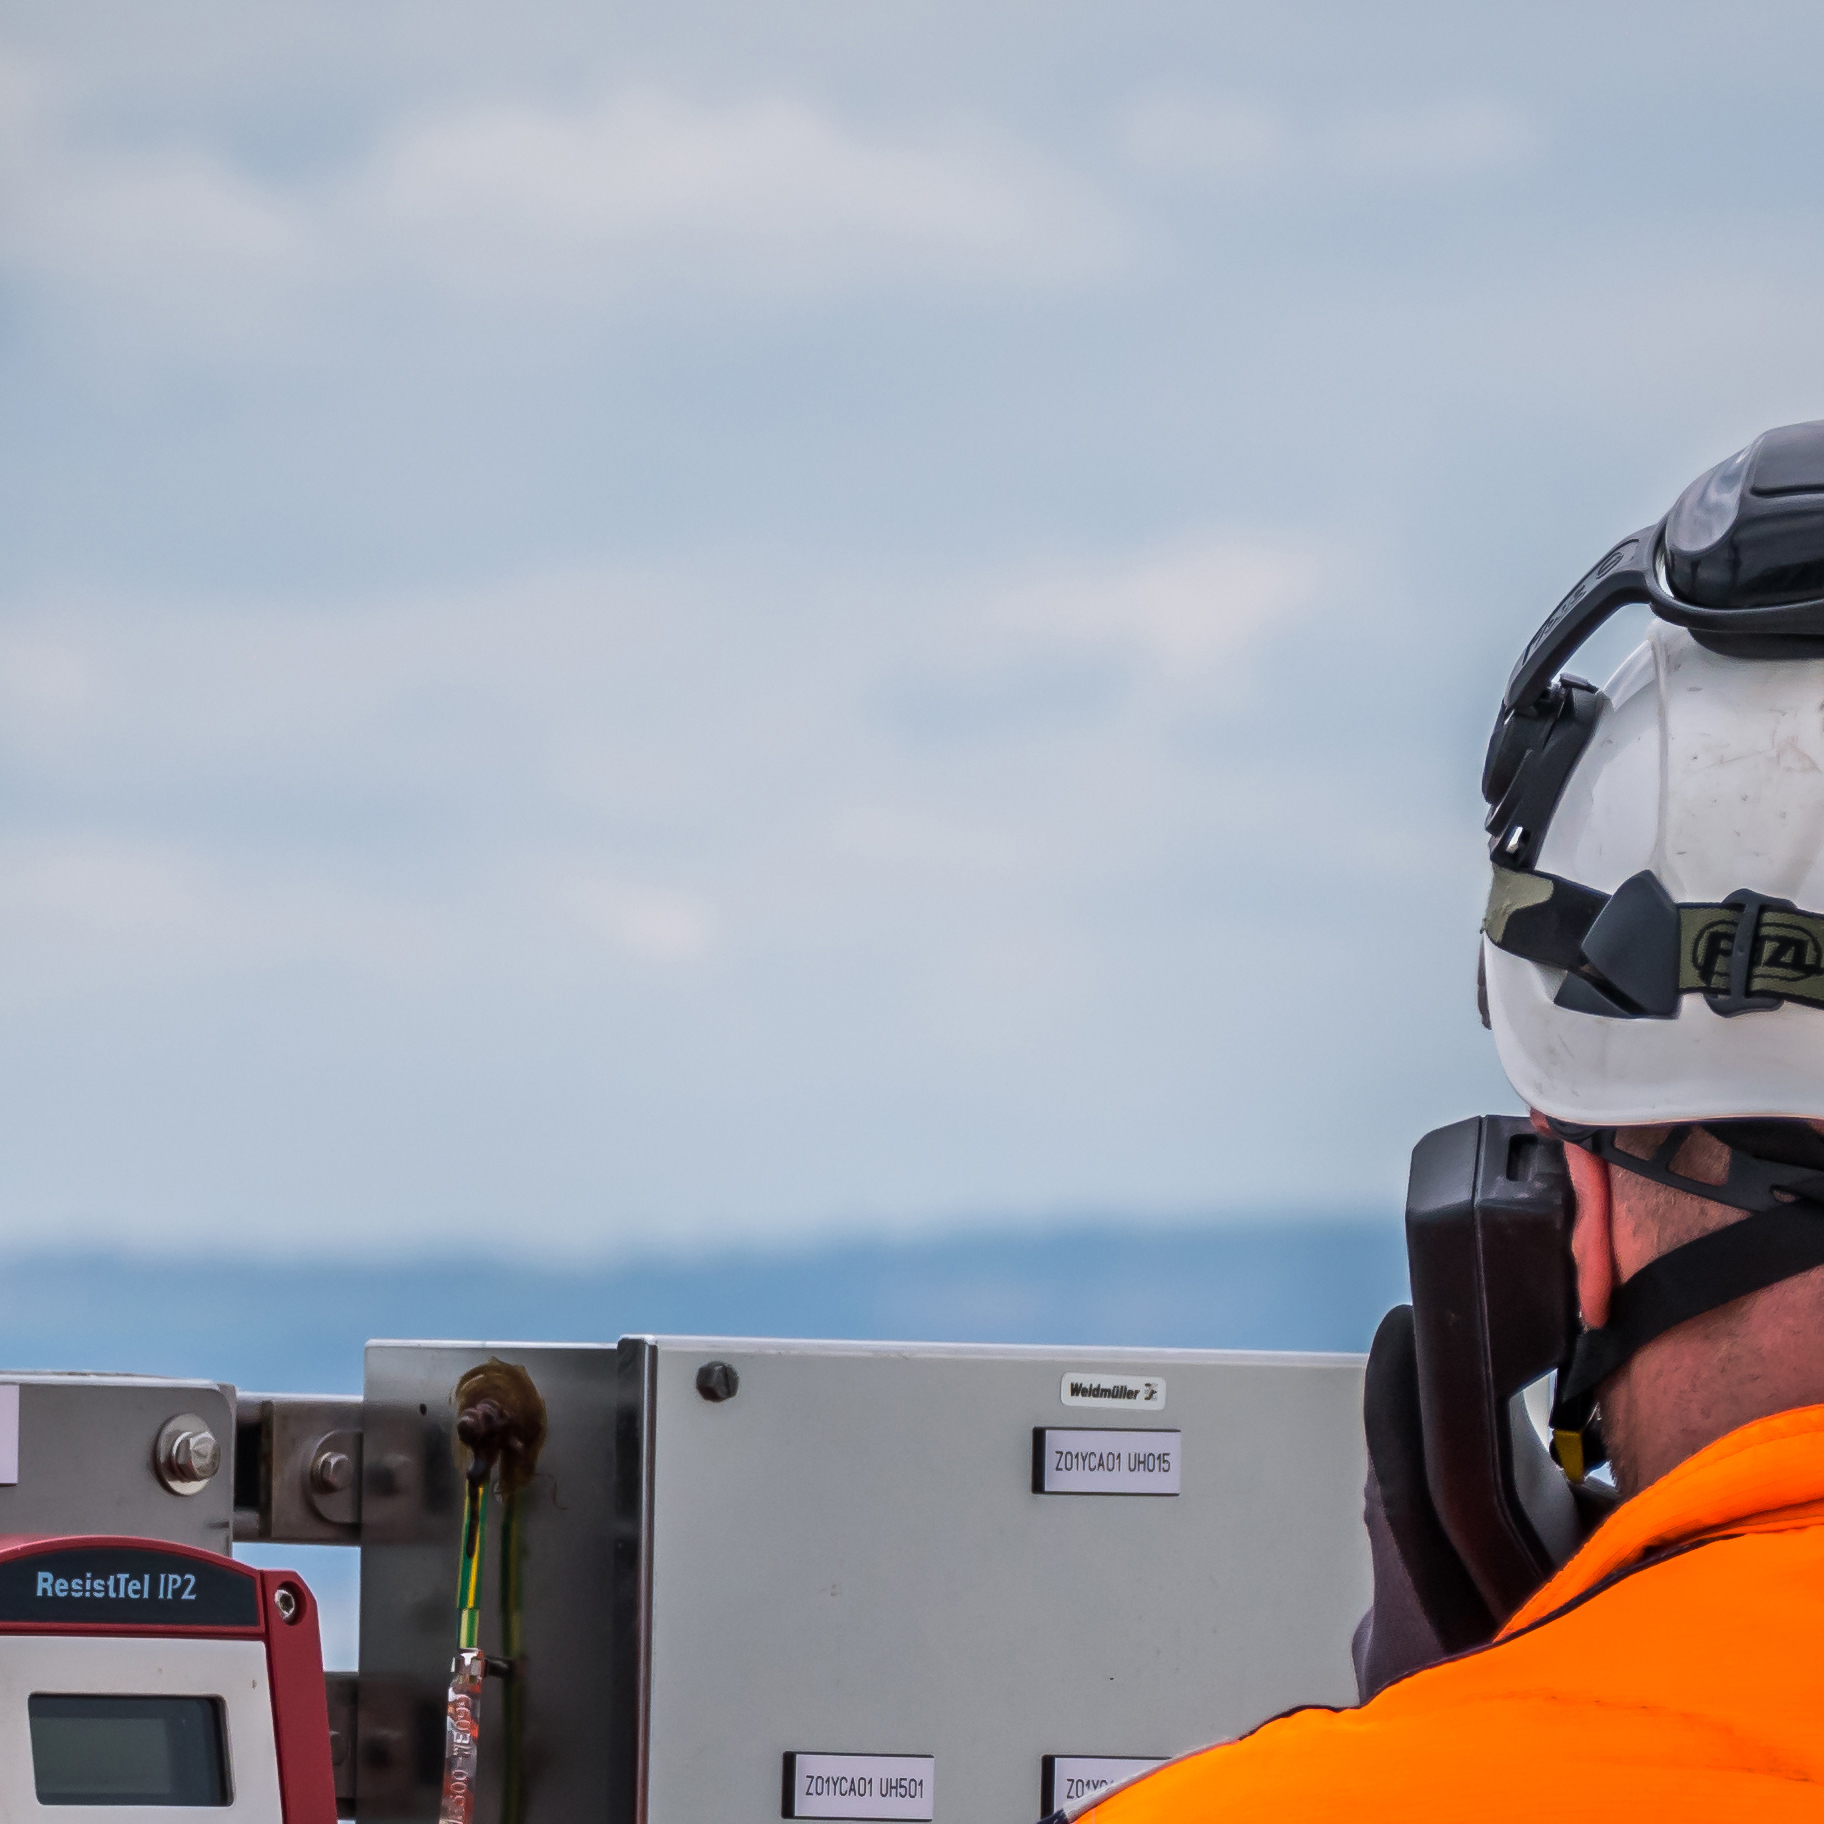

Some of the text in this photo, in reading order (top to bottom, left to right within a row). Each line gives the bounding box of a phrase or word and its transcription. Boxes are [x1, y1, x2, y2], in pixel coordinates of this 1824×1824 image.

[1055, 1451, 1171, 1473] Z01YCA01 UH015
[36, 1571, 197, 1600] ResistTel IP2
[805, 1775, 924, 1799] Z01YCA01 UH501
